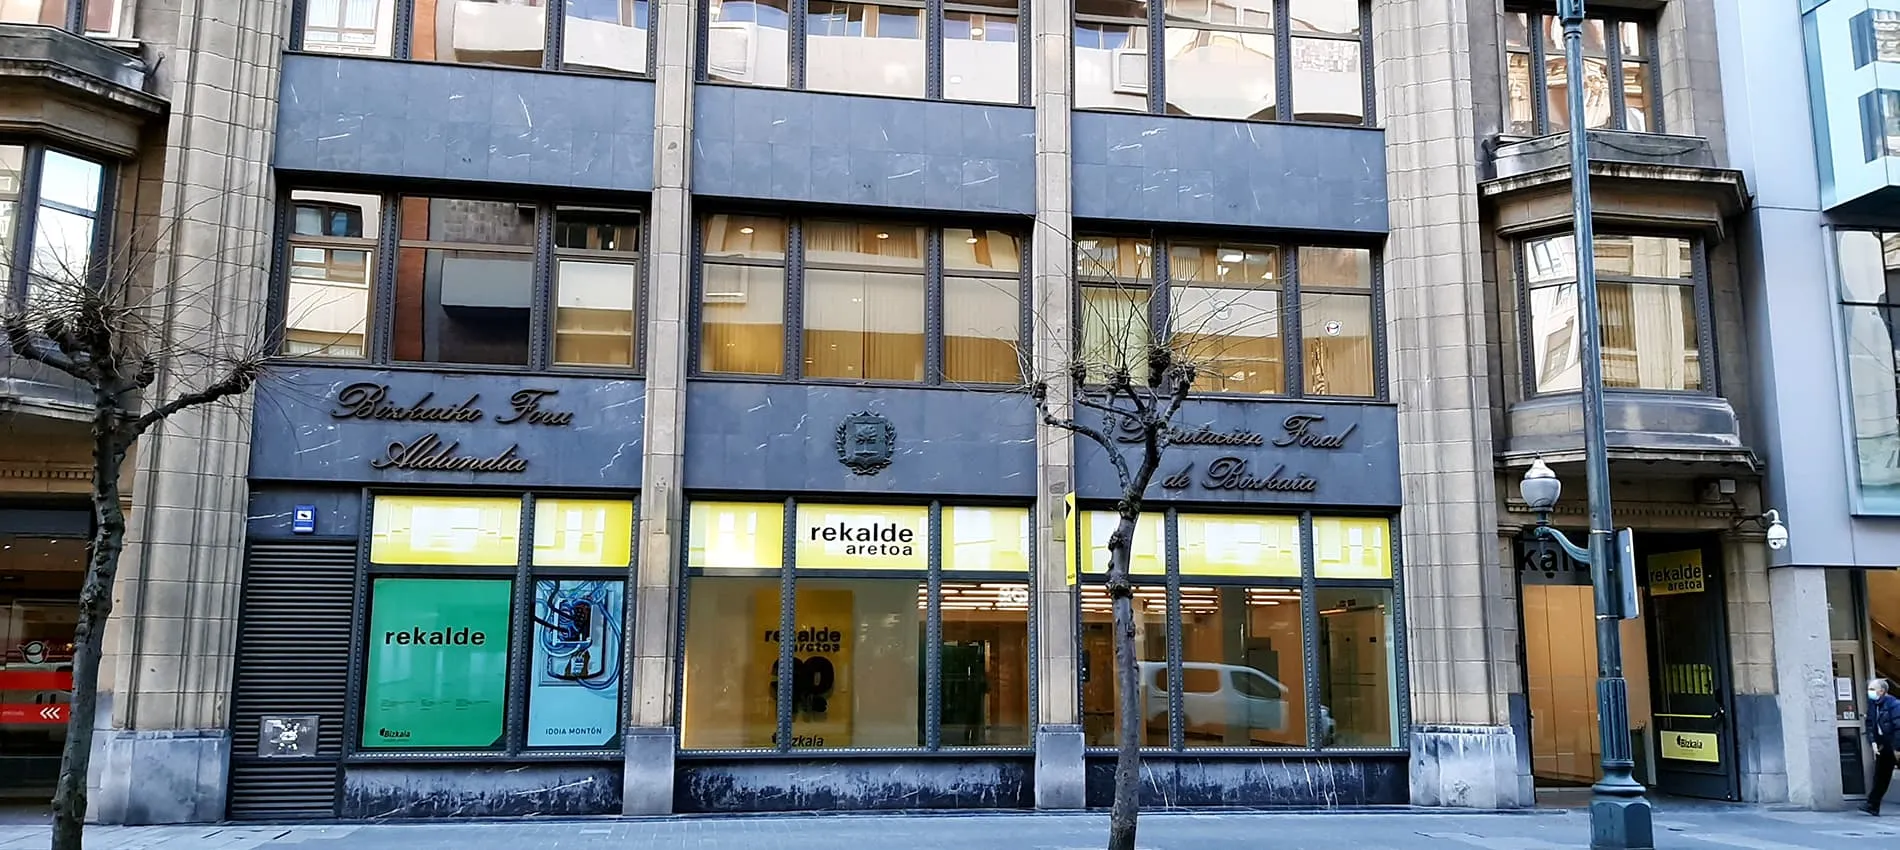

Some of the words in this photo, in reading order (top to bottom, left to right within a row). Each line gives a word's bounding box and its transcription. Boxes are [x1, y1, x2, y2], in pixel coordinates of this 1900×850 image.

[331, 382, 483, 424] Bizkaiko
[495, 388, 576, 426] Foru
[1272, 413, 1358, 449] Foral
[371, 432, 528, 473] Aldundia
[1161, 461, 1195, 492] de
[1202, 456, 1318, 492] Bizkaia
[810, 522, 914, 543] rekalde
[845, 543, 914, 557] aretoa
[1649, 562, 1702, 583] rekalde
[1667, 580, 1703, 591] aretoa
[385, 626, 486, 646] rekalde
[764, 626, 842, 643] realde
[545, 727, 567, 736] IDOIA
[568, 726, 602, 735] MONTÓN
